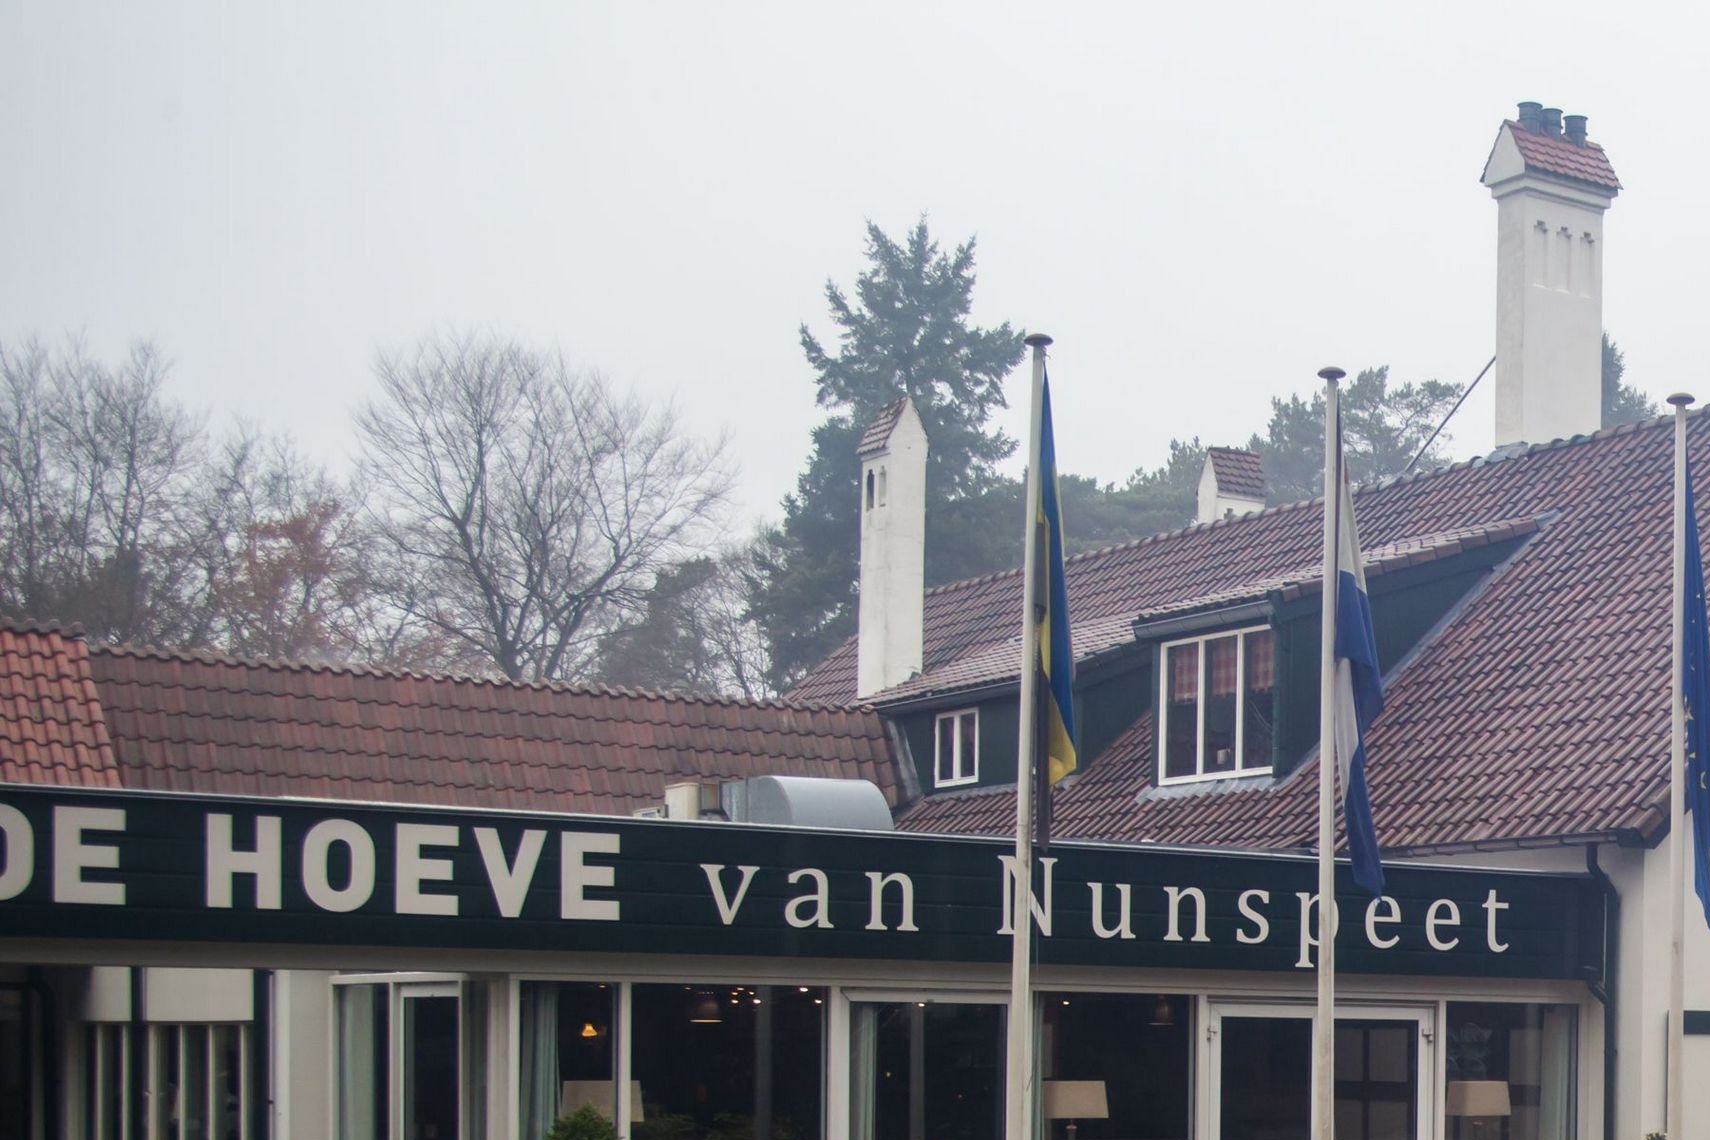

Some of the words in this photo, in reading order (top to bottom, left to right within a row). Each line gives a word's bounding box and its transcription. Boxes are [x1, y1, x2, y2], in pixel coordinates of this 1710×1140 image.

[205, 812, 622, 922] HOEVE
[699, 863, 920, 932] van
[996, 854, 1511, 969] Nunspeet
